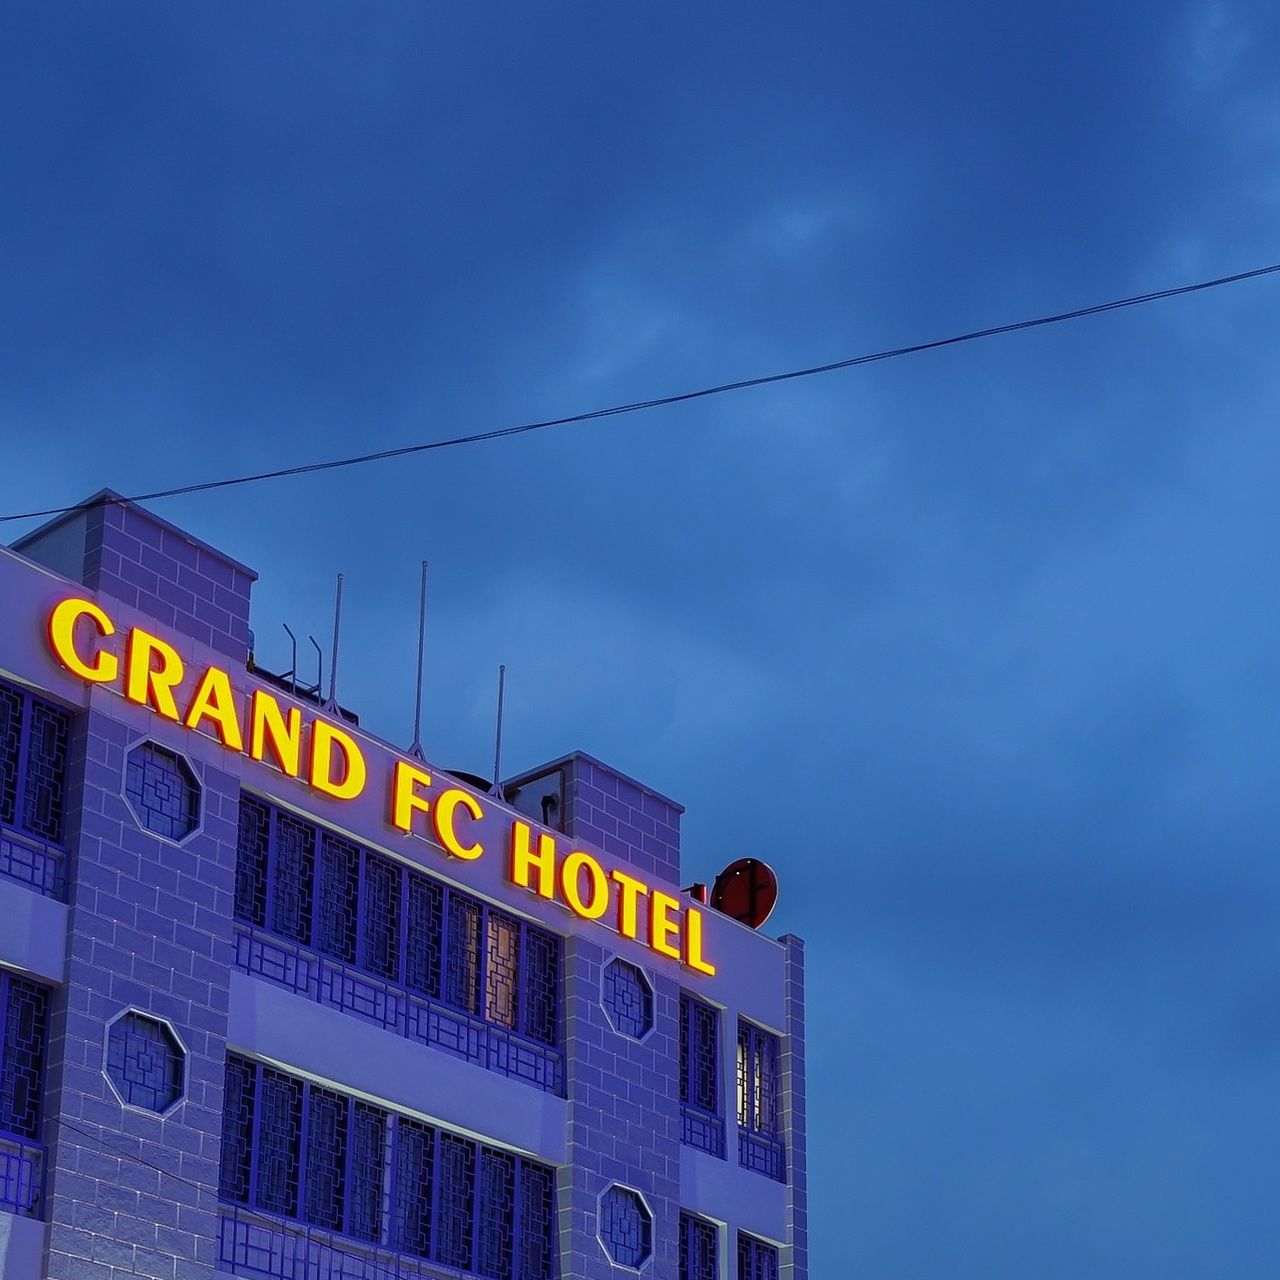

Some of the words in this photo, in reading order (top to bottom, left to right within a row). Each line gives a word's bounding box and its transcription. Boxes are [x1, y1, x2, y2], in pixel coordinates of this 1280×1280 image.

[46, 598, 368, 800] GRAND
[393, 760, 485, 861] FC
[510, 820, 717, 977] HOTEL
